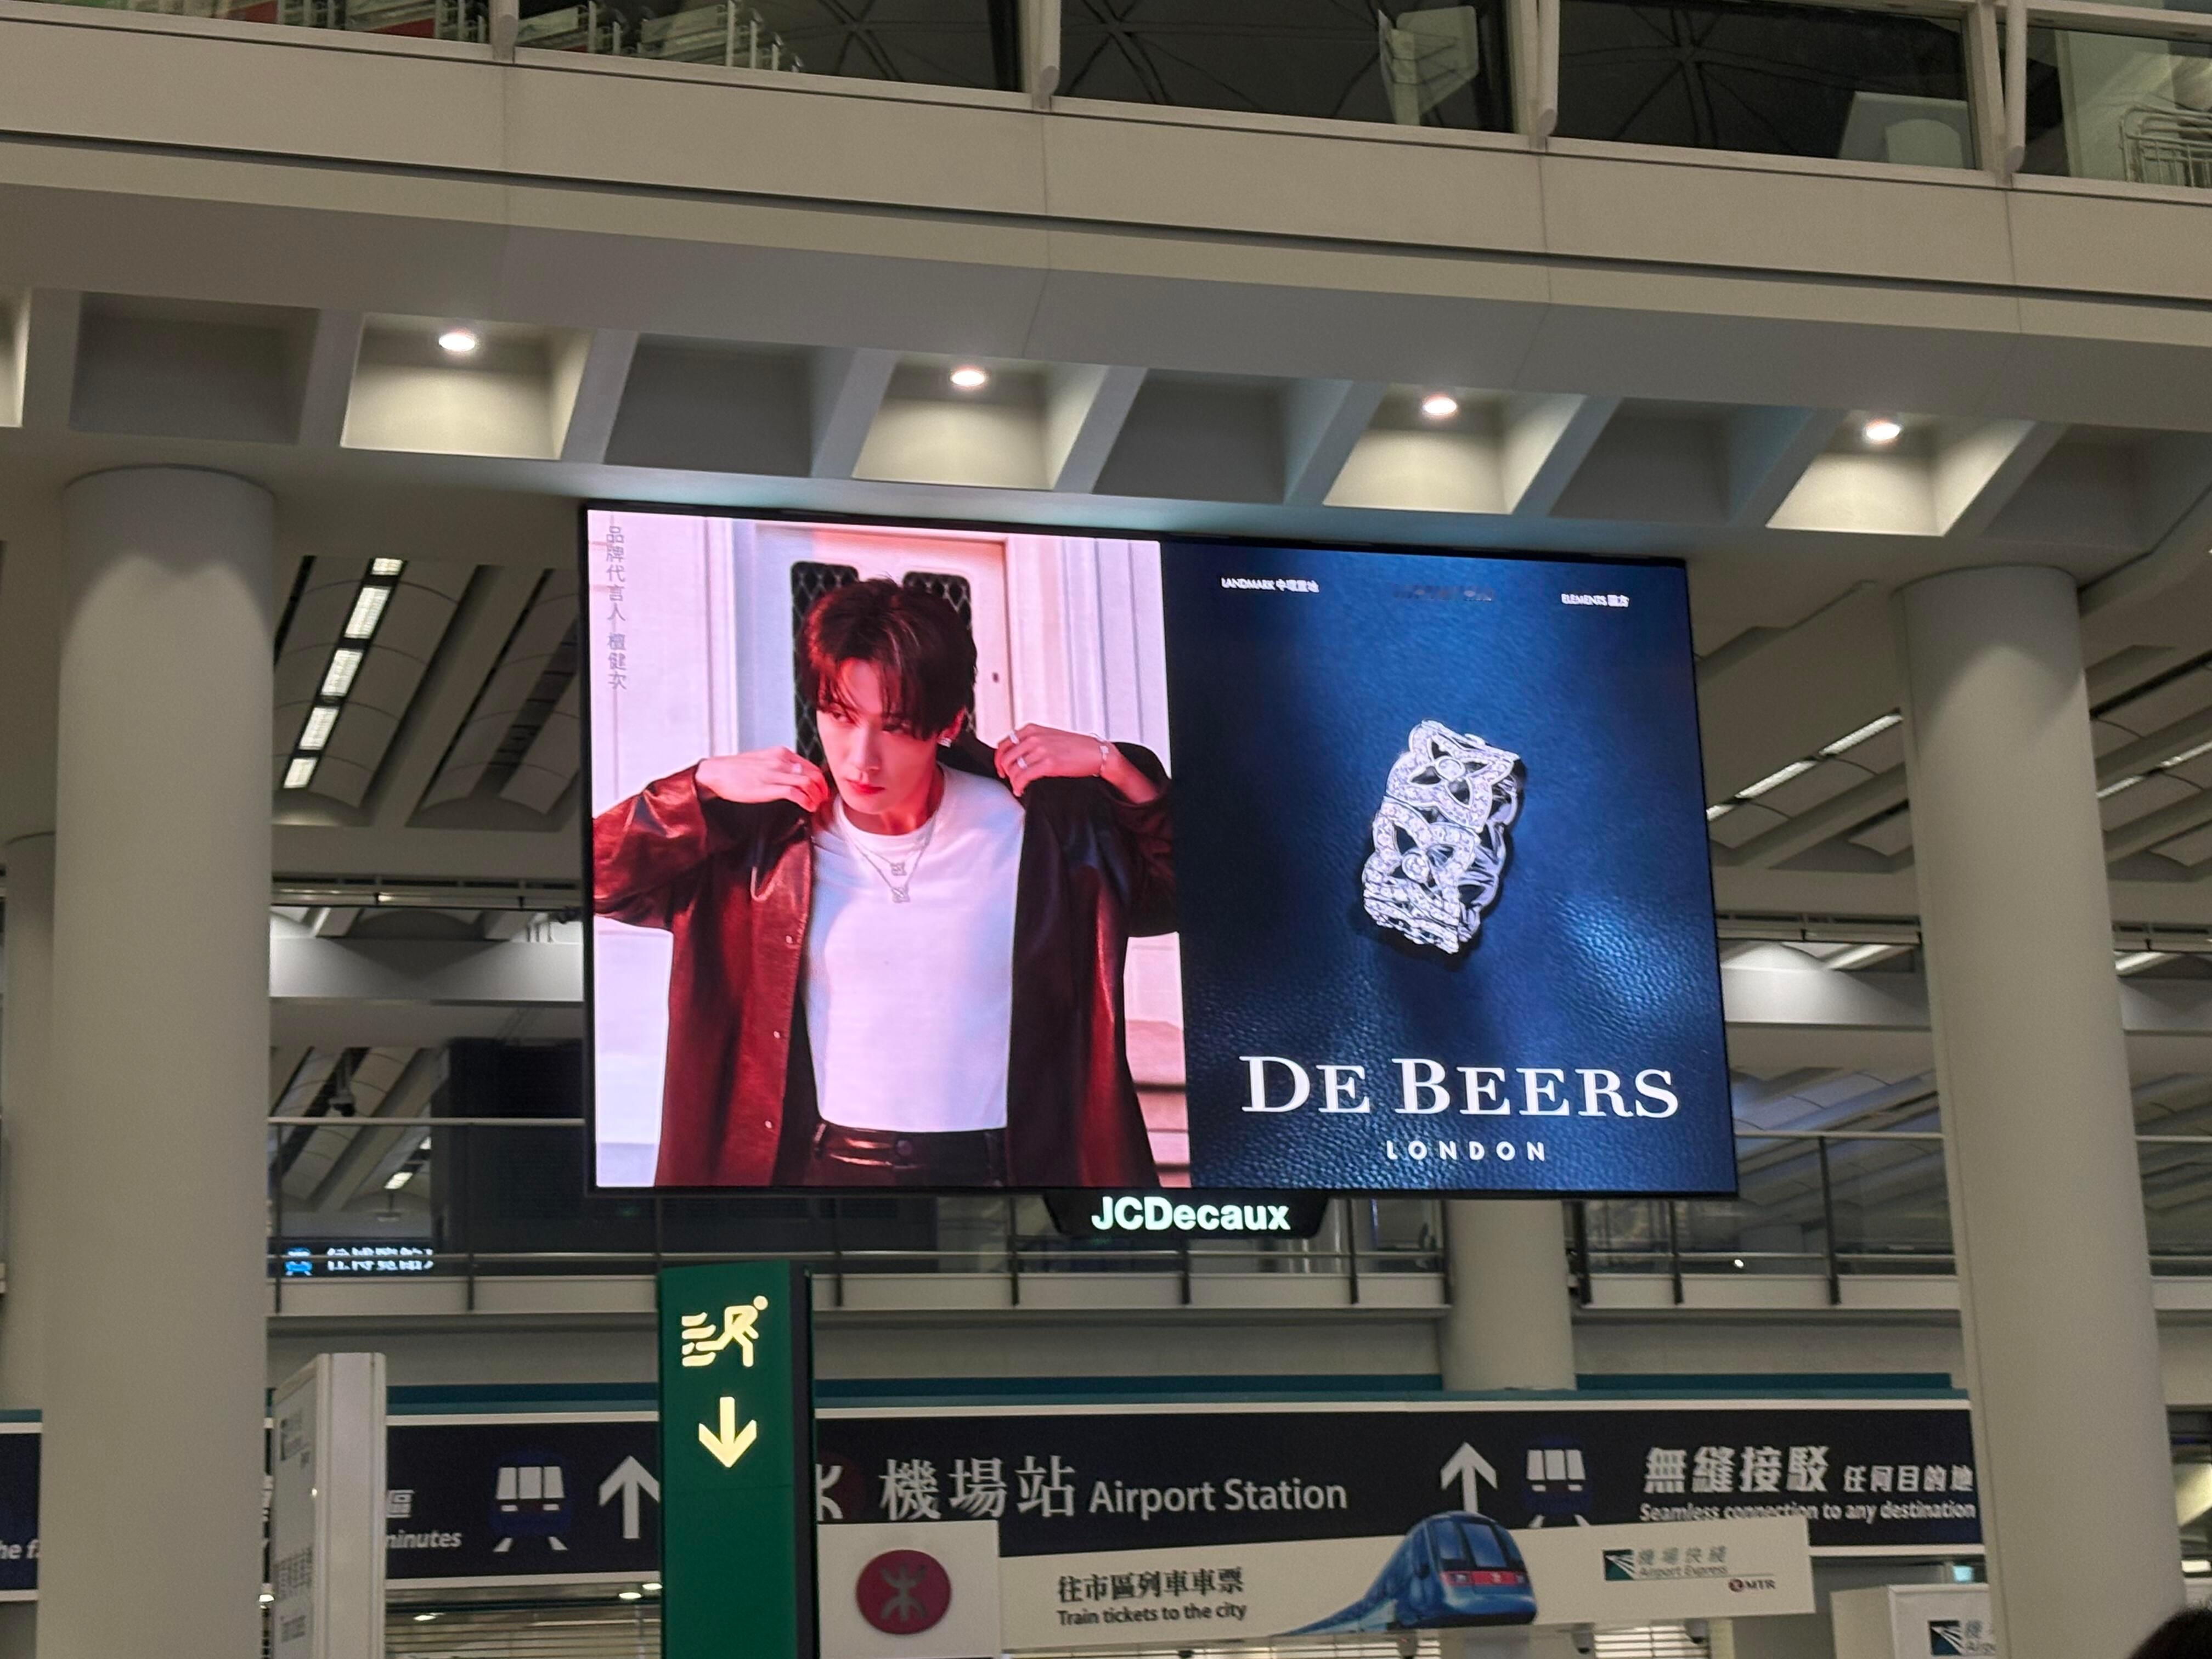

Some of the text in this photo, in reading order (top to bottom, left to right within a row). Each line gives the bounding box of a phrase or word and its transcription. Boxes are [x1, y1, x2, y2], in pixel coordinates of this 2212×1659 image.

[606, 525, 626, 622] 品牌代言人
[1221, 578, 1276, 591] LANDMARK
[1561, 594, 1607, 606] ELEMENTS
[1239, 1056, 1679, 1118] DE BEERS
[1387, 1141, 1545, 1161] LONDON
[1091, 1196, 1291, 1231] JCDecaux
[1643, 1446, 1830, 1493] 無縫接駁
[879, 1455, 1348, 1521] 機場站 Airport Station
[1639, 1503, 1720, 1521] Seamless
[1822, 1502, 1842, 1520] to
[1844, 1504, 1878, 1525] any
[1880, 1500, 1976, 1519] destination
[1057, 1600, 1247, 1626] Train tickets to the city
